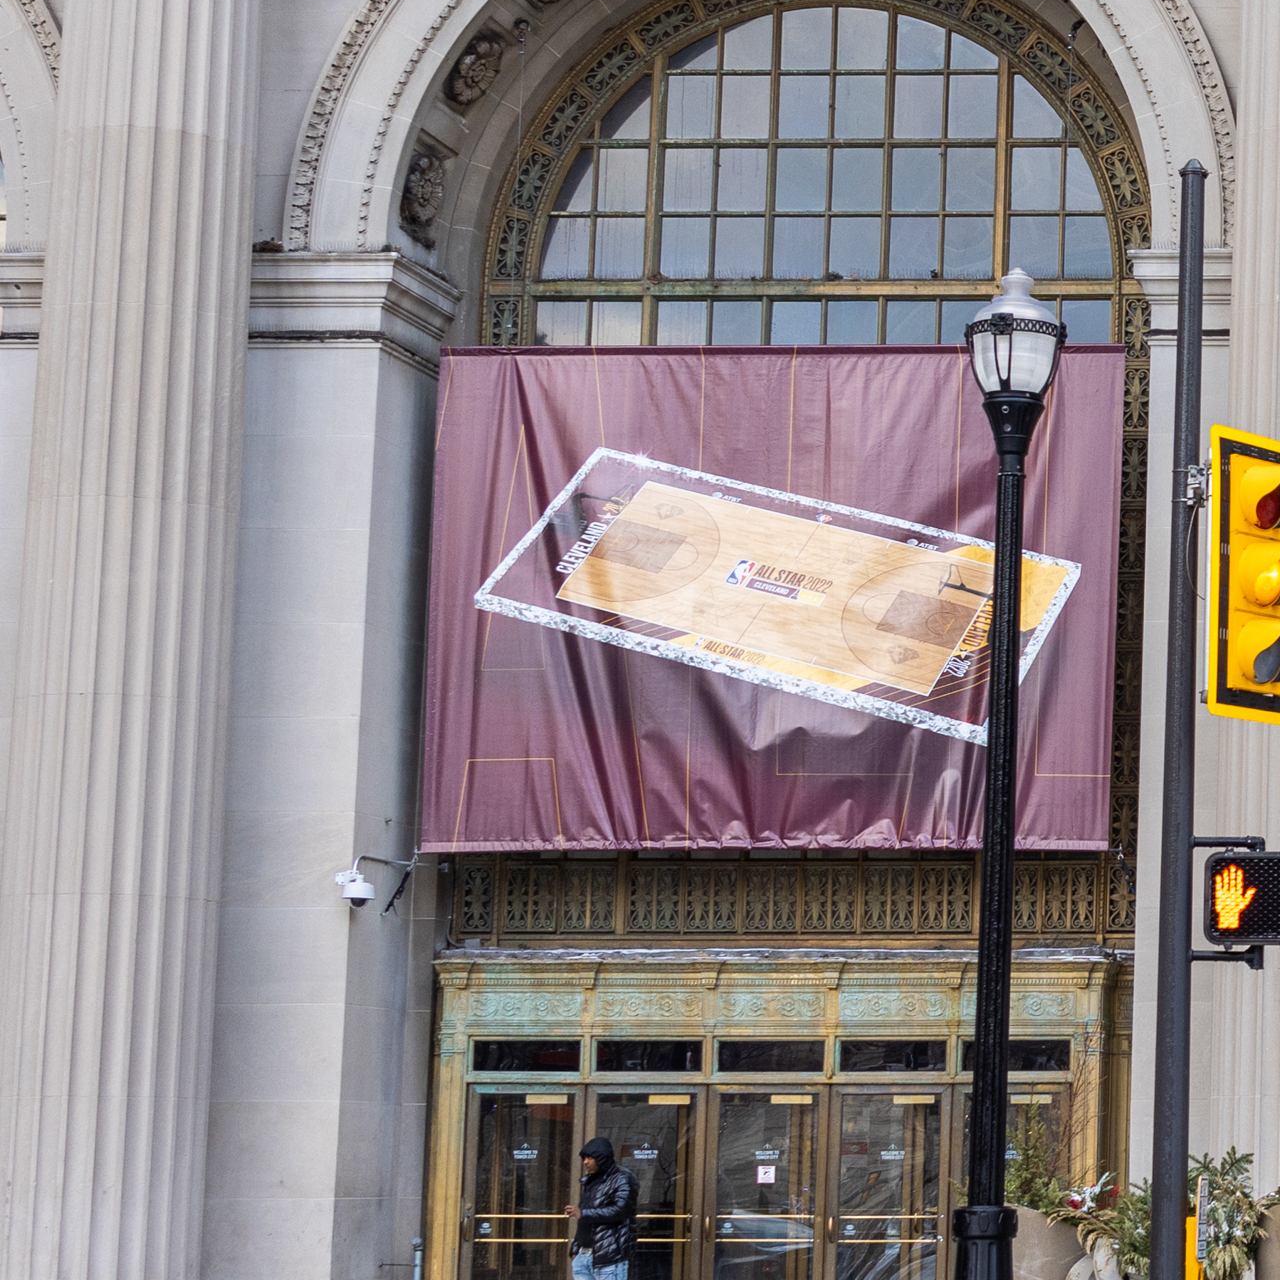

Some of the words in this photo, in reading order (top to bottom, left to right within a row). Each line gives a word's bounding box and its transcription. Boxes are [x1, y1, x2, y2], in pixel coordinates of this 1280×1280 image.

[555, 521, 608, 574] CLEVELAND
[753, 564, 776, 580] ALL
[774, 569, 806, 587] STAR
[802, 576, 834, 594] 2022
[753, 581, 790, 595] CLEVELAND
[742, 651, 766, 666] 2022
[943, 656, 972, 678] 2022
